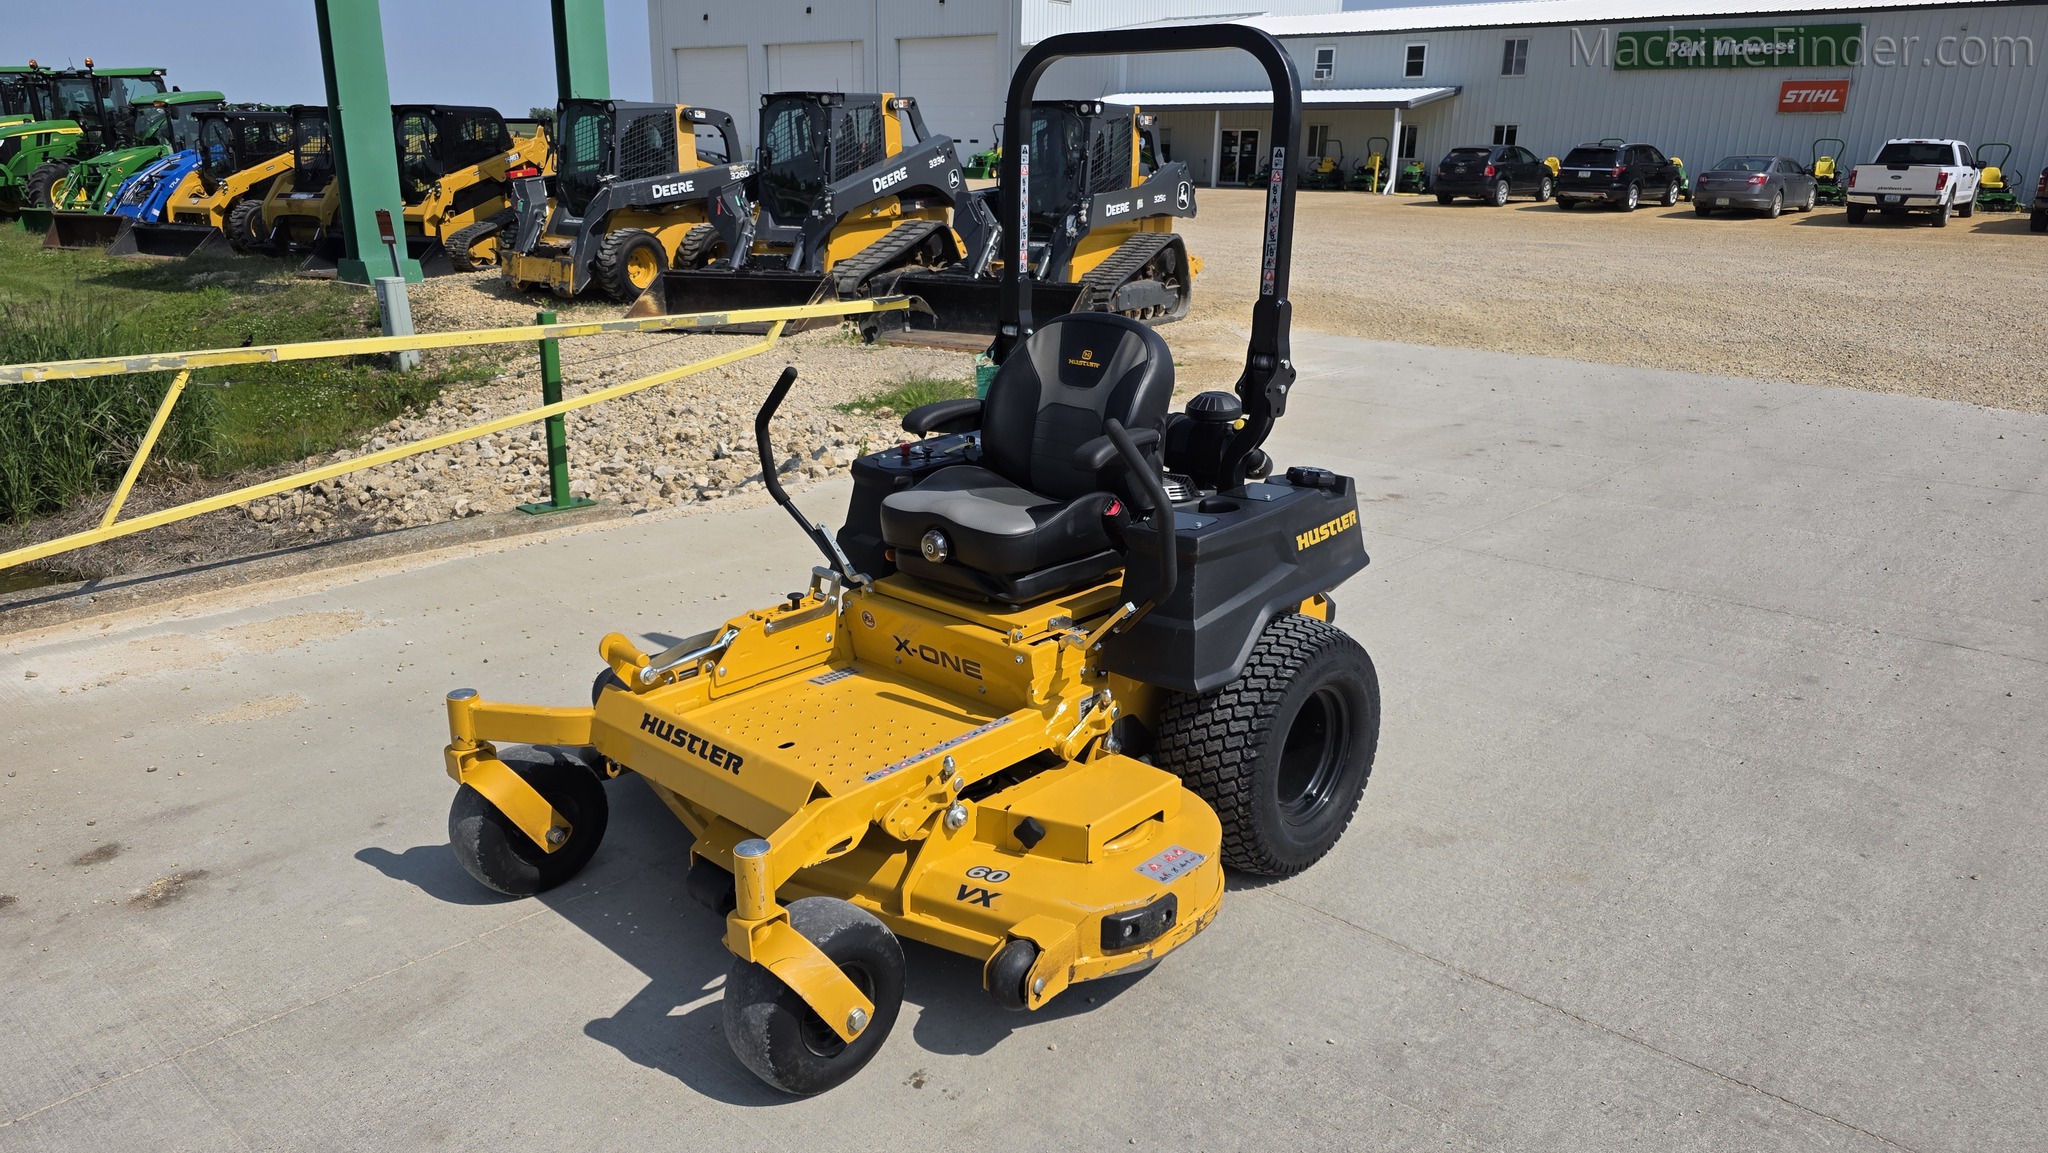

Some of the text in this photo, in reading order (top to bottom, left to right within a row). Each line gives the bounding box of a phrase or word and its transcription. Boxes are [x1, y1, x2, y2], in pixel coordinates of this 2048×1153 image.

[1666, 39, 1796, 57] P&K Midwest
[1782, 89, 1840, 103] STIHL
[928, 155, 946, 169] 333G
[730, 170, 750, 180] 326D
[872, 166, 908, 194] DEERE
[651, 180, 695, 199] DEERE
[1153, 194, 1167, 204] 325G
[1105, 201, 1131, 217] DEERE
[1296, 509, 1357, 551] HUSTLER
[893, 634, 983, 680] X-ONE
[640, 712, 744, 776] HUSTLER
[966, 866, 1010, 883] 60
[956, 884, 1003, 908] VX
